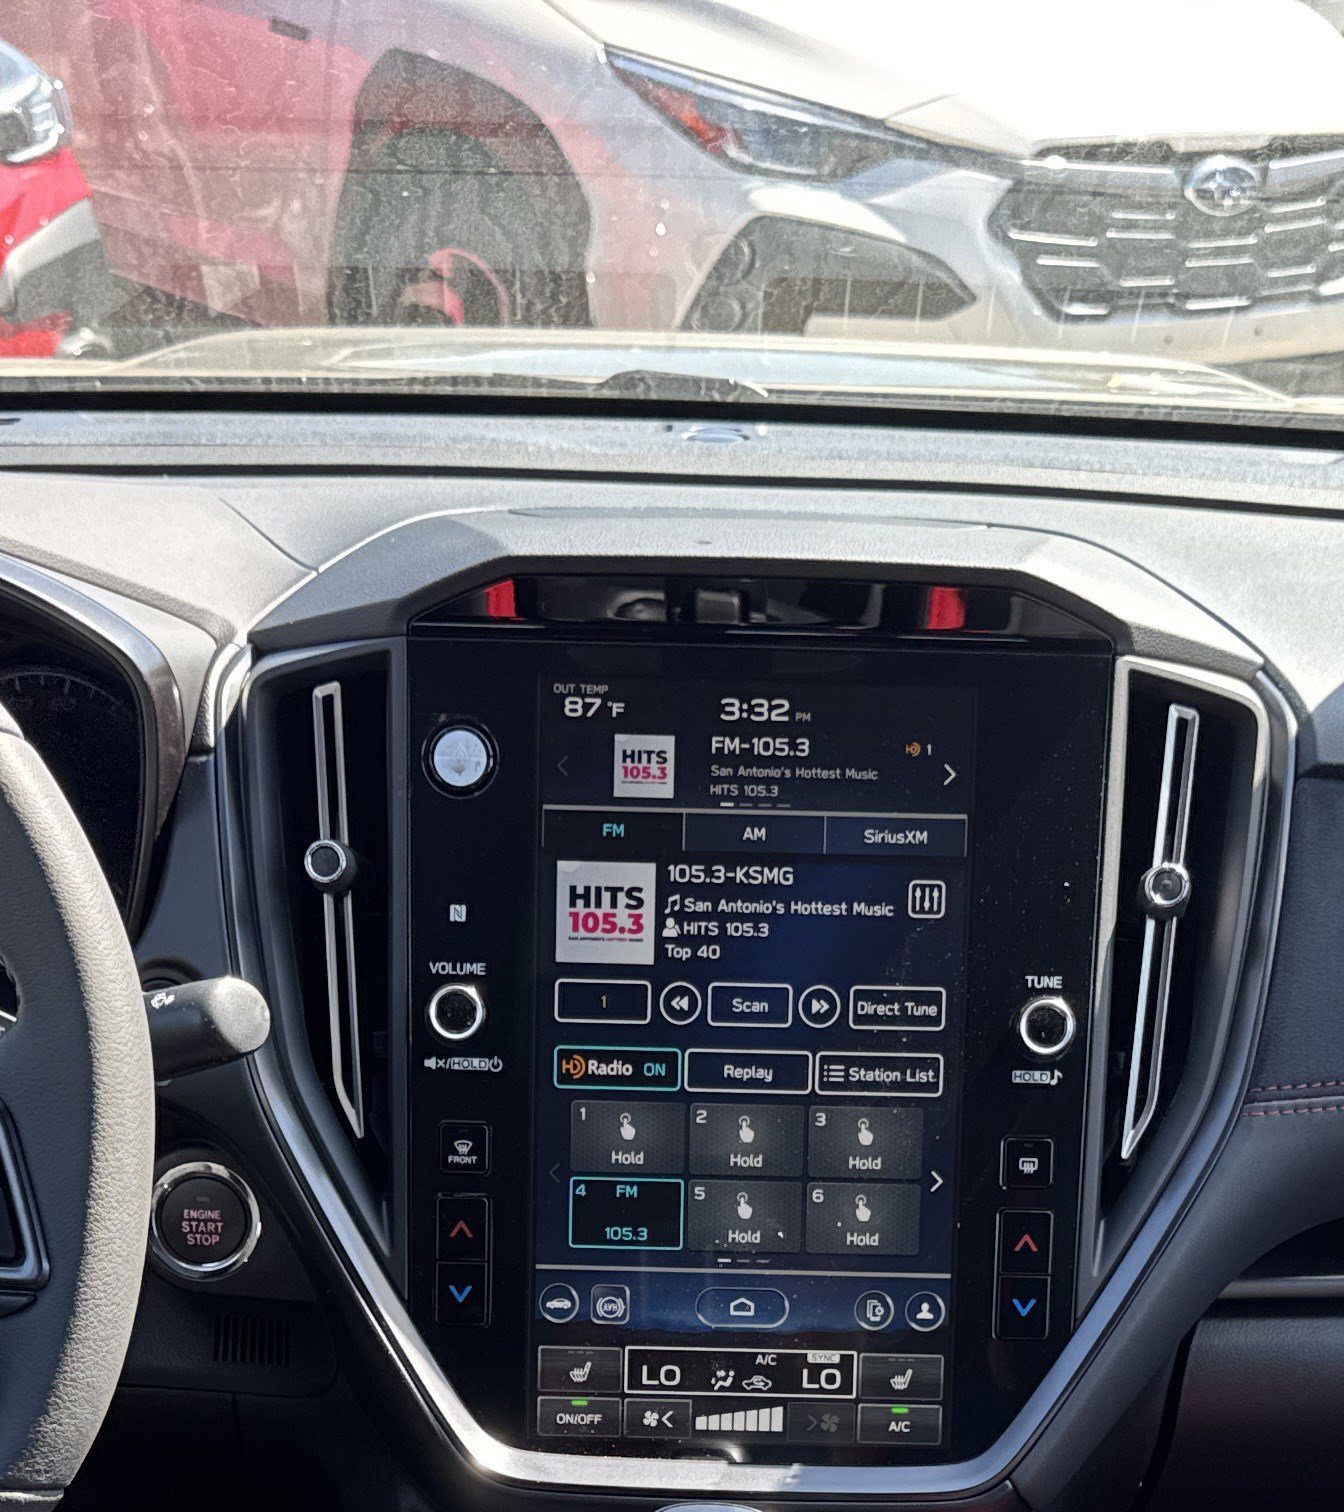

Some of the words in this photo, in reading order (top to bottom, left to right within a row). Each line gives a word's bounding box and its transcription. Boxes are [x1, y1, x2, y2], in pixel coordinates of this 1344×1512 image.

[553, 683, 576, 694] OUT
[580, 684, 609, 695] TEMP
[564, 696, 602, 718] 87
[719, 697, 791, 722] 3:32
[795, 712, 811, 722] PM
[710, 736, 810, 757] FM-105.3
[622, 749, 668, 765] HITS
[621, 765, 668, 780] 105.3
[710, 765, 733, 778] San
[737, 766, 791, 779] Antonio's
[796, 767, 842, 780] Hottest
[846, 768, 878, 781] Music
[709, 784, 739, 797] HITS
[744, 785, 779, 798] 105.3
[602, 823, 625, 838] FM
[742, 827, 767, 842] AM
[863, 829, 928, 845] SiriusXM
[667, 864, 794, 886] 105.3-KSMG
[568, 885, 645, 911] HITS
[683, 897, 712, 913] San
[718, 898, 785, 915] Antonio's
[790, 900, 847, 916] Hottest
[852, 901, 895, 917] Music
[568, 911, 645, 935] 105.3
[683, 921, 719, 936] HITS
[725, 922, 770, 938] 105.3
[664, 943, 692, 961] Top
[697, 944, 721, 960] 40
[429, 961, 487, 976] VOLUME
[1024, 975, 1063, 989] TUNE
[731, 998, 769, 1013] Scan
[857, 1001, 900, 1017] Direct
[904, 1002, 939, 1017] Tune
[587, 1059, 633, 1076] Radio
[643, 1062, 666, 1077] ON
[723, 1064, 774, 1083] Replay
[849, 1066, 901, 1082] Station
[906, 1068, 935, 1083] List
[1013, 1072, 1050, 1083] HOLD
[579, 1107, 587, 1121] 1
[695, 1109, 708, 1124] 2
[814, 1112, 827, 1127] 3
[447, 1155, 478, 1165] FRONT
[611, 1151, 645, 1165] Hold
[729, 1154, 763, 1168] Hold
[848, 1156, 882, 1170] Hold
[575, 1183, 587, 1197] 4
[615, 1184, 638, 1199] FM
[693, 1186, 706, 1201] 5
[811, 1189, 825, 1203] 6
[182, 1208, 222, 1220] ENGINE
[181, 1221, 224, 1233] START
[604, 1226, 648, 1241] 105.3
[186, 1233, 220, 1246] STOP
[727, 1229, 761, 1244] Hold
[846, 1232, 880, 1247] Hold
[755, 1354, 778, 1366] A/C
[811, 1353, 836, 1362] SYNC
[641, 1364, 682, 1386] LO
[801, 1368, 842, 1390] LO
[556, 1413, 603, 1425] ON/OFF
[888, 1420, 911, 1432] A/C
